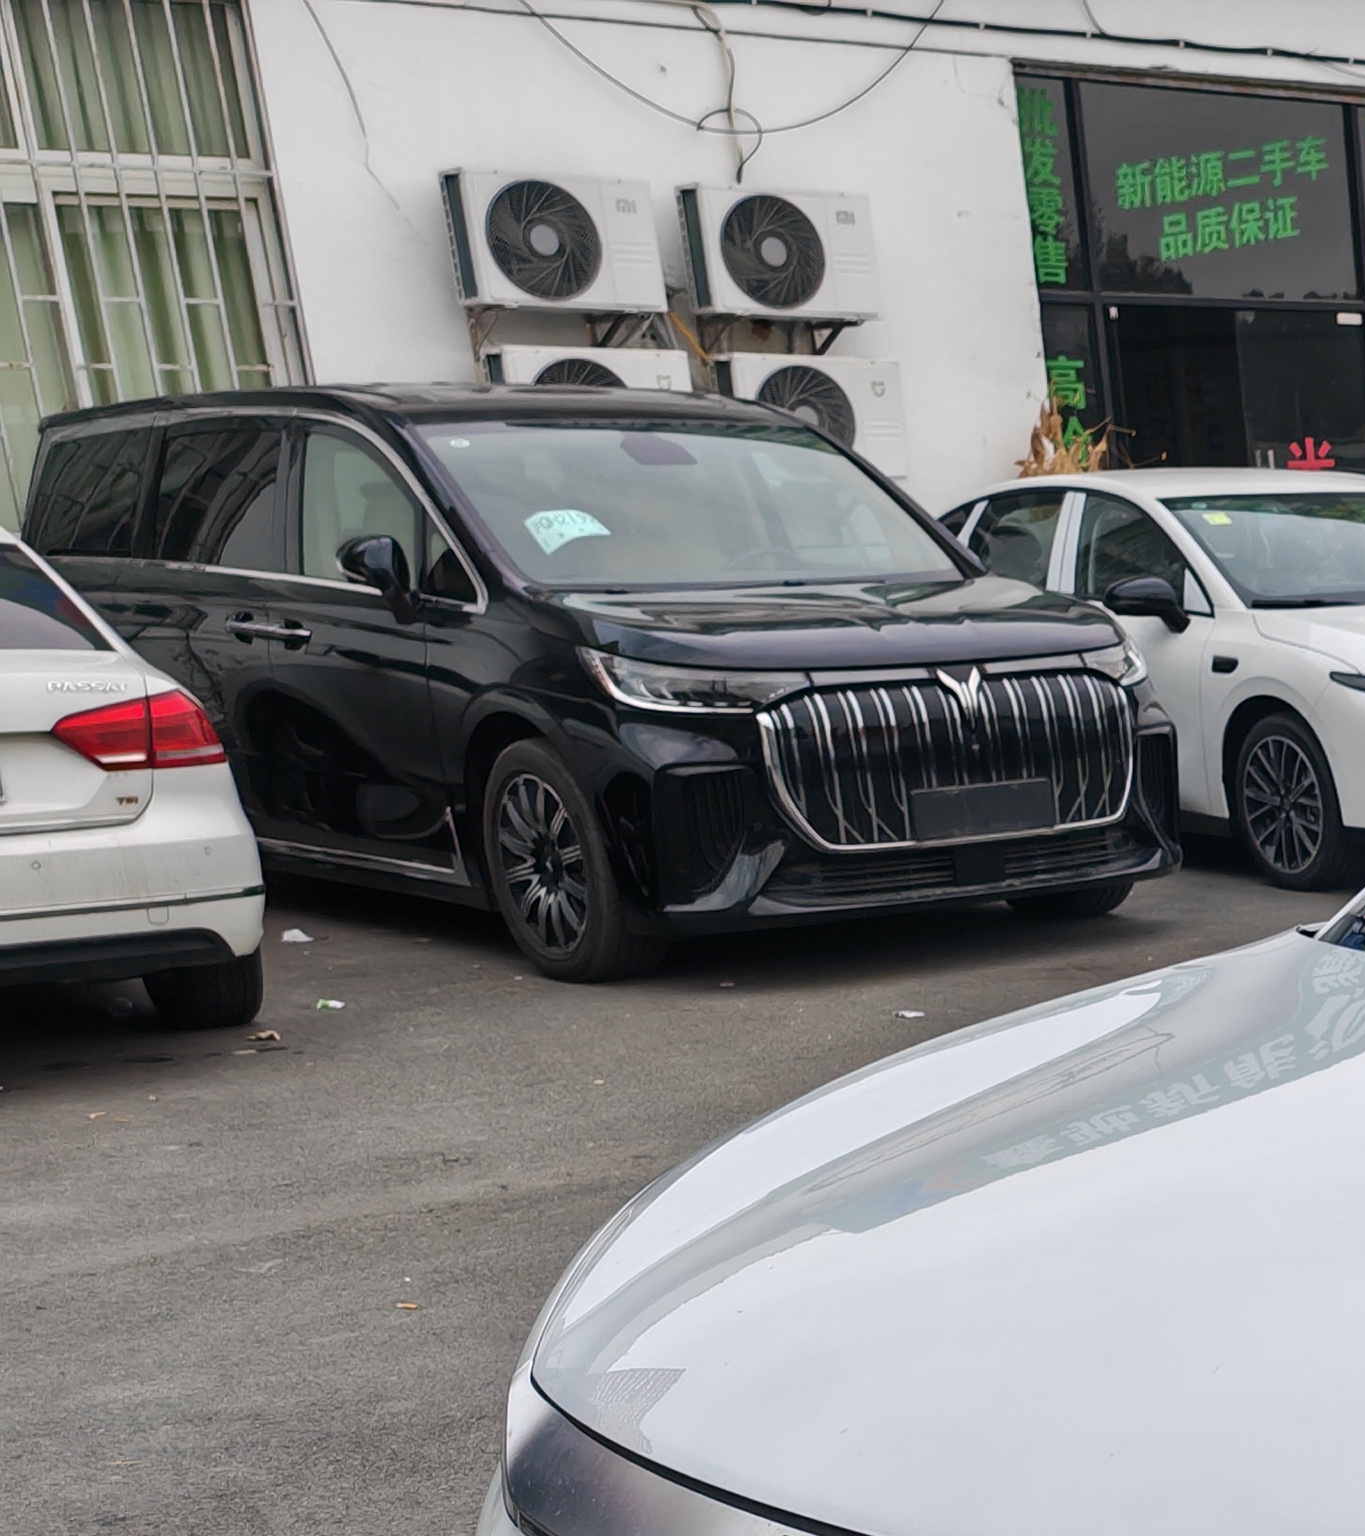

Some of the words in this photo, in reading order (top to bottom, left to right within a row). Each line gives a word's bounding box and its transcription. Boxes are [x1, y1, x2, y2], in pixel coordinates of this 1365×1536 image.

[1115, 136, 1329, 210] 新能源二手车
[1159, 196, 1301, 261] 品质保证
[47, 681, 128, 692] PASSAT
